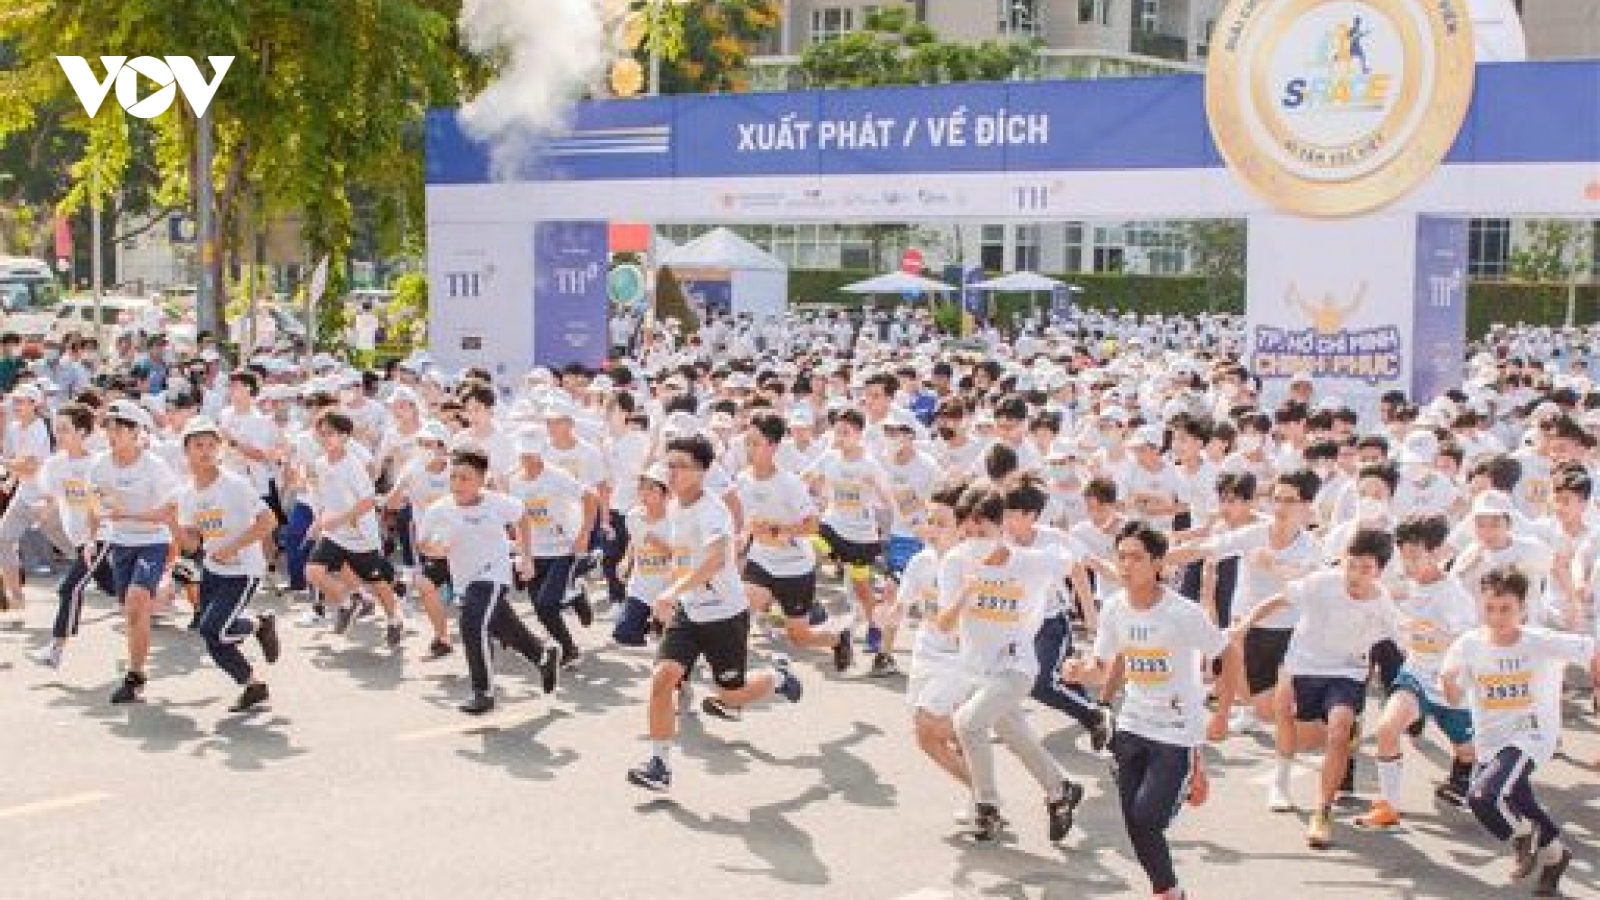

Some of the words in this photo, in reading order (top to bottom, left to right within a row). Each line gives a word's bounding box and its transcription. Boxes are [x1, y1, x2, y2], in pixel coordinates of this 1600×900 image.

[737, 111, 812, 150] XUẤT
[817, 111, 895, 150] PHÁT
[901, 117, 919, 148] /
[974, 107, 1049, 145] ĐÍCH
